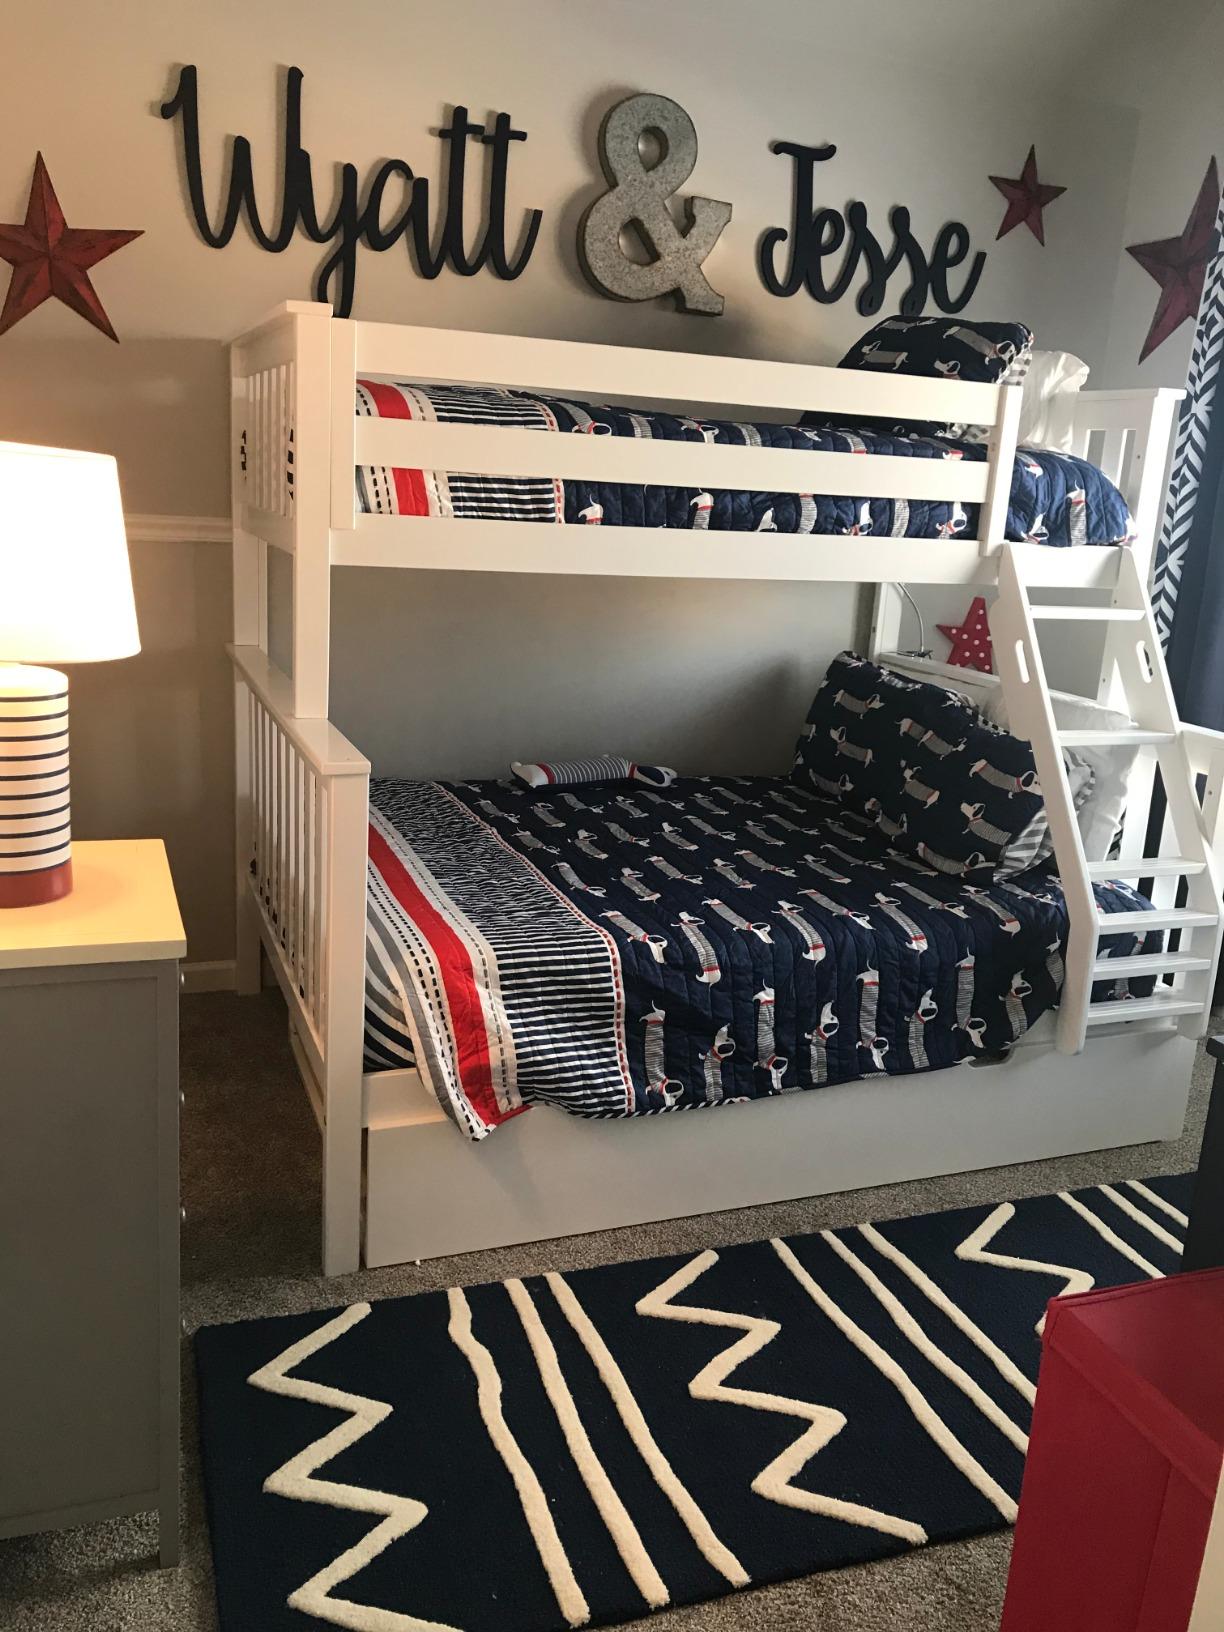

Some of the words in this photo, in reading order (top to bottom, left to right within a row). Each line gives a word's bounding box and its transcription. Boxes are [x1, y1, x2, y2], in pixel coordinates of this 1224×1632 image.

[161, 65, 543, 319] Wyatt
[576, 93, 732, 316] &
[760, 141, 987, 316] Jesse
